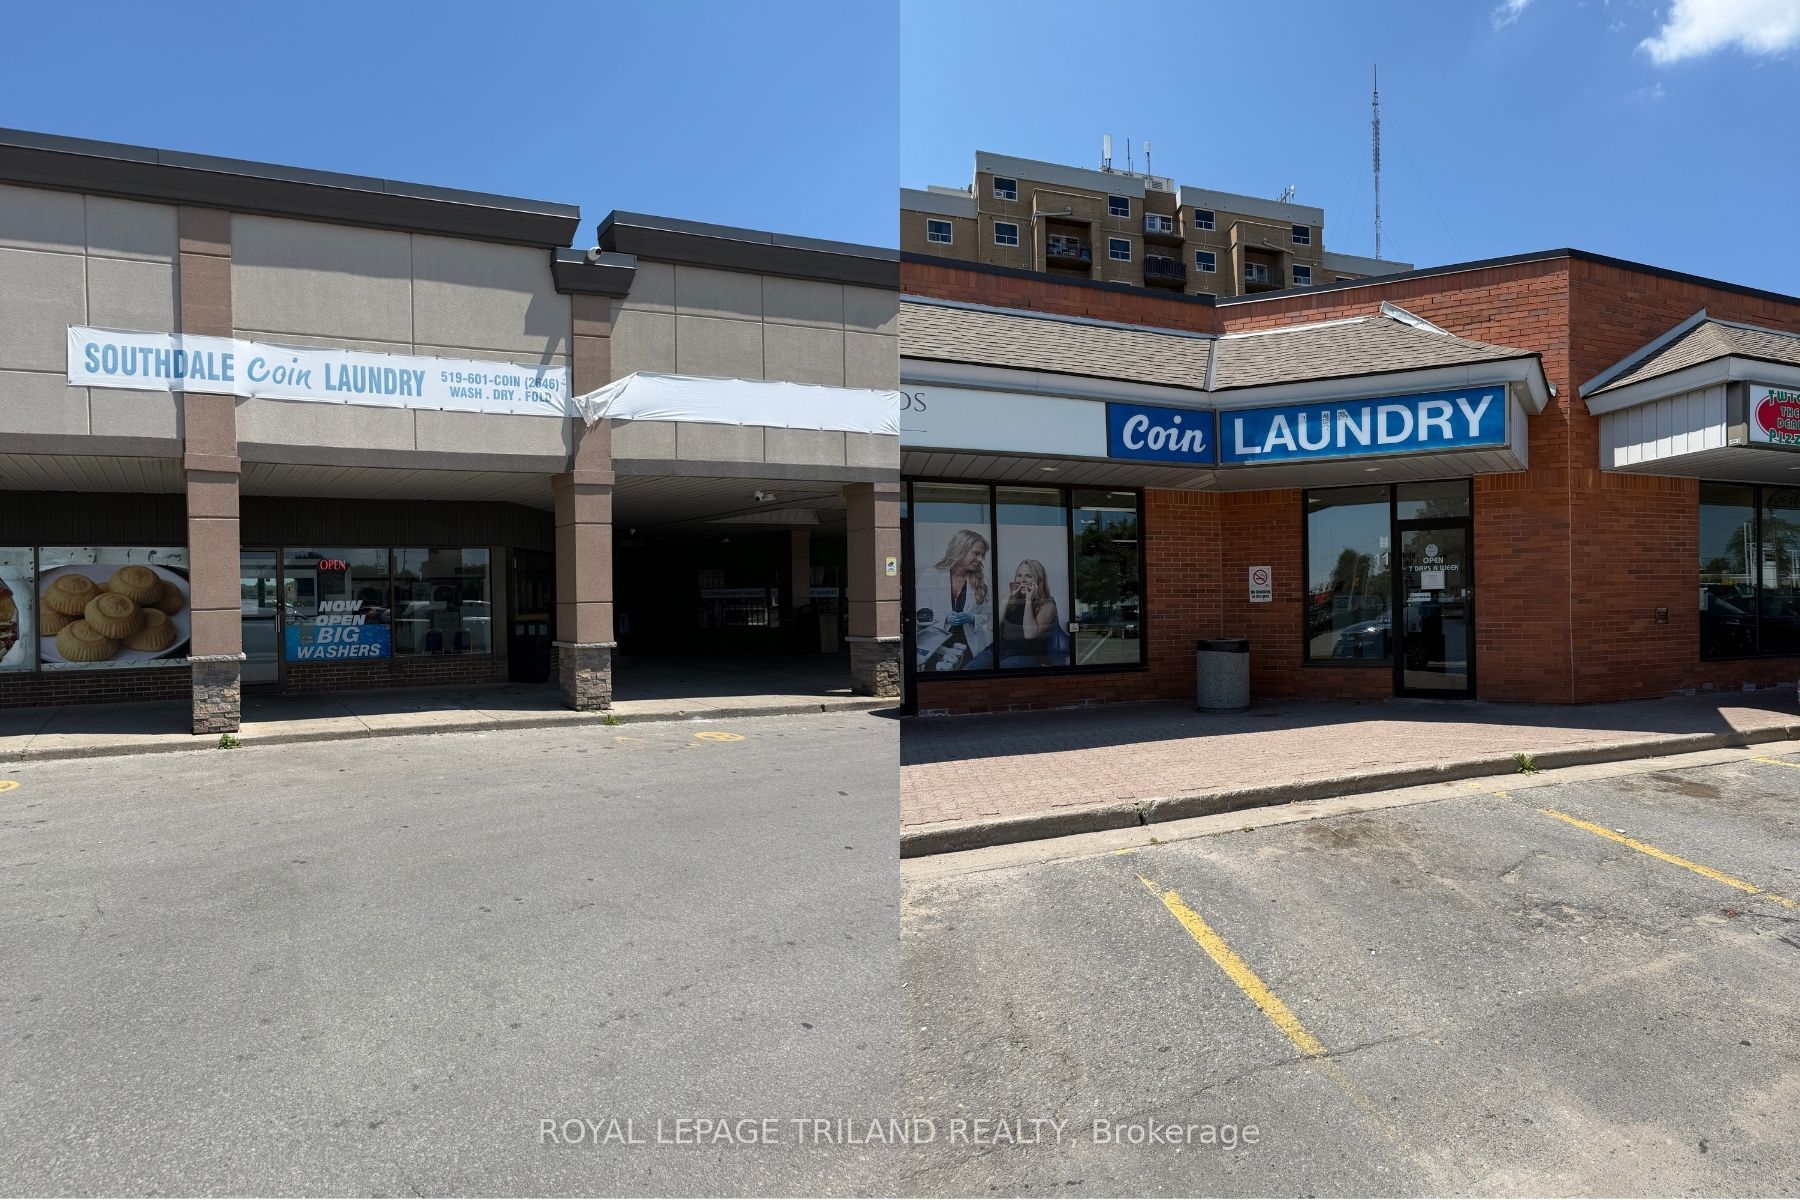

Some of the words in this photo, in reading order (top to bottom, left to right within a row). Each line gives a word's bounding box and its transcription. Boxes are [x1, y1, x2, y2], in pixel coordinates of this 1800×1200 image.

[84, 342, 235, 382] SOUTHDALE
[247, 356, 312, 390] Coin
[324, 362, 426, 398] LAUNDRY
[440, 371, 521, 387] 519-601-COIN
[524, 376, 559, 392] (2646)
[449, 386, 482, 399] WASH
[493, 389, 515, 401] DRY
[525, 391, 552, 403] FOLD
[1122, 413, 1207, 453] Coin
[1234, 394, 1494, 455] LAUNDRY
[320, 560, 346, 570] OPEN
[1422, 556, 1444, 564] OPEN
[319, 600, 362, 612] NOW
[316, 615, 366, 626] OPEN
[317, 626, 360, 643] BIG
[298, 644, 380, 658] WASHERS
